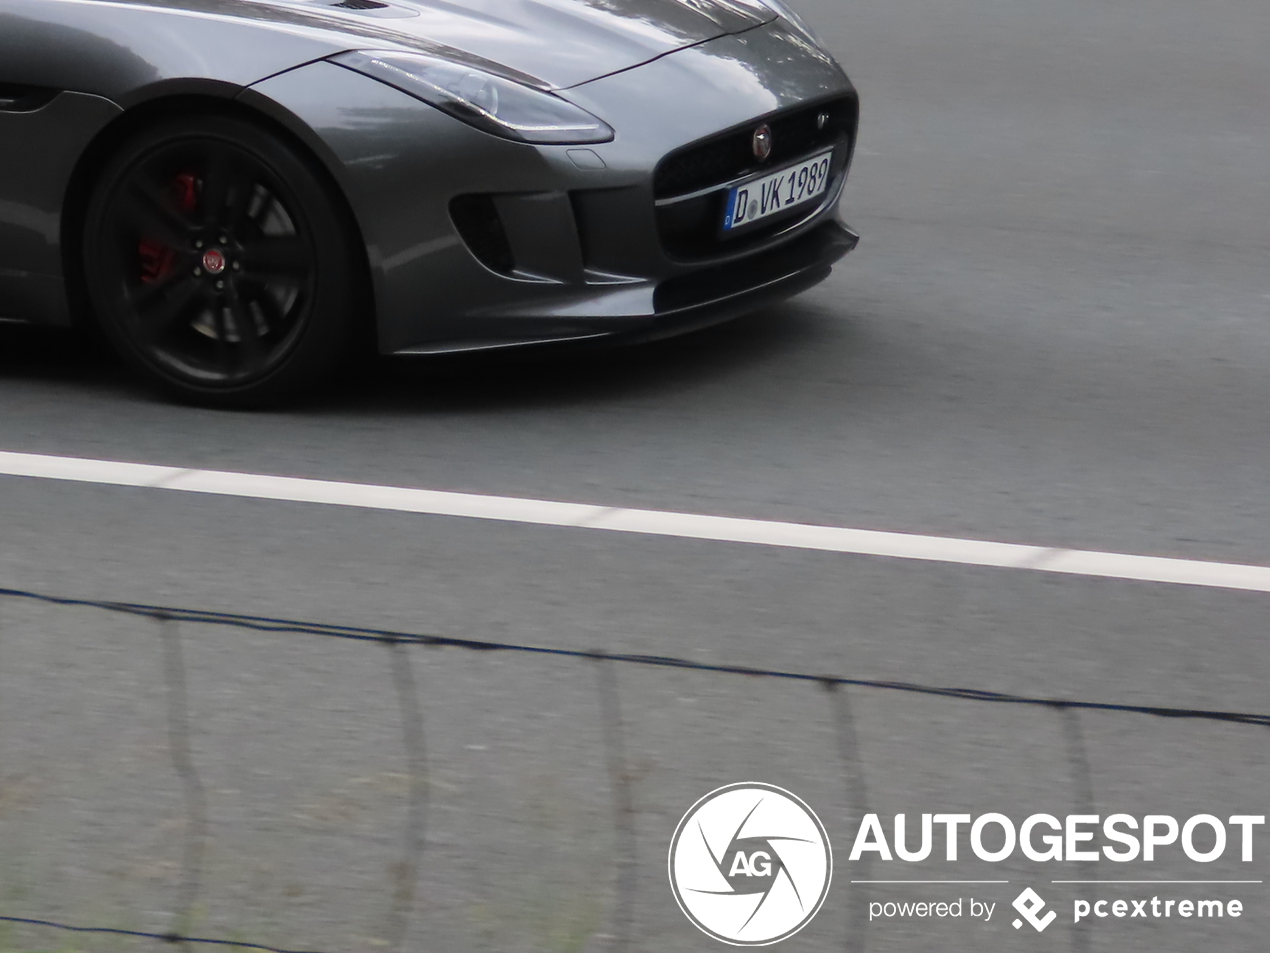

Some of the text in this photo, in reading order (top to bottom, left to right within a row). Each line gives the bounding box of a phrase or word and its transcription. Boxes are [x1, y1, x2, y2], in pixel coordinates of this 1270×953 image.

[734, 158, 828, 223] D VK 1989
